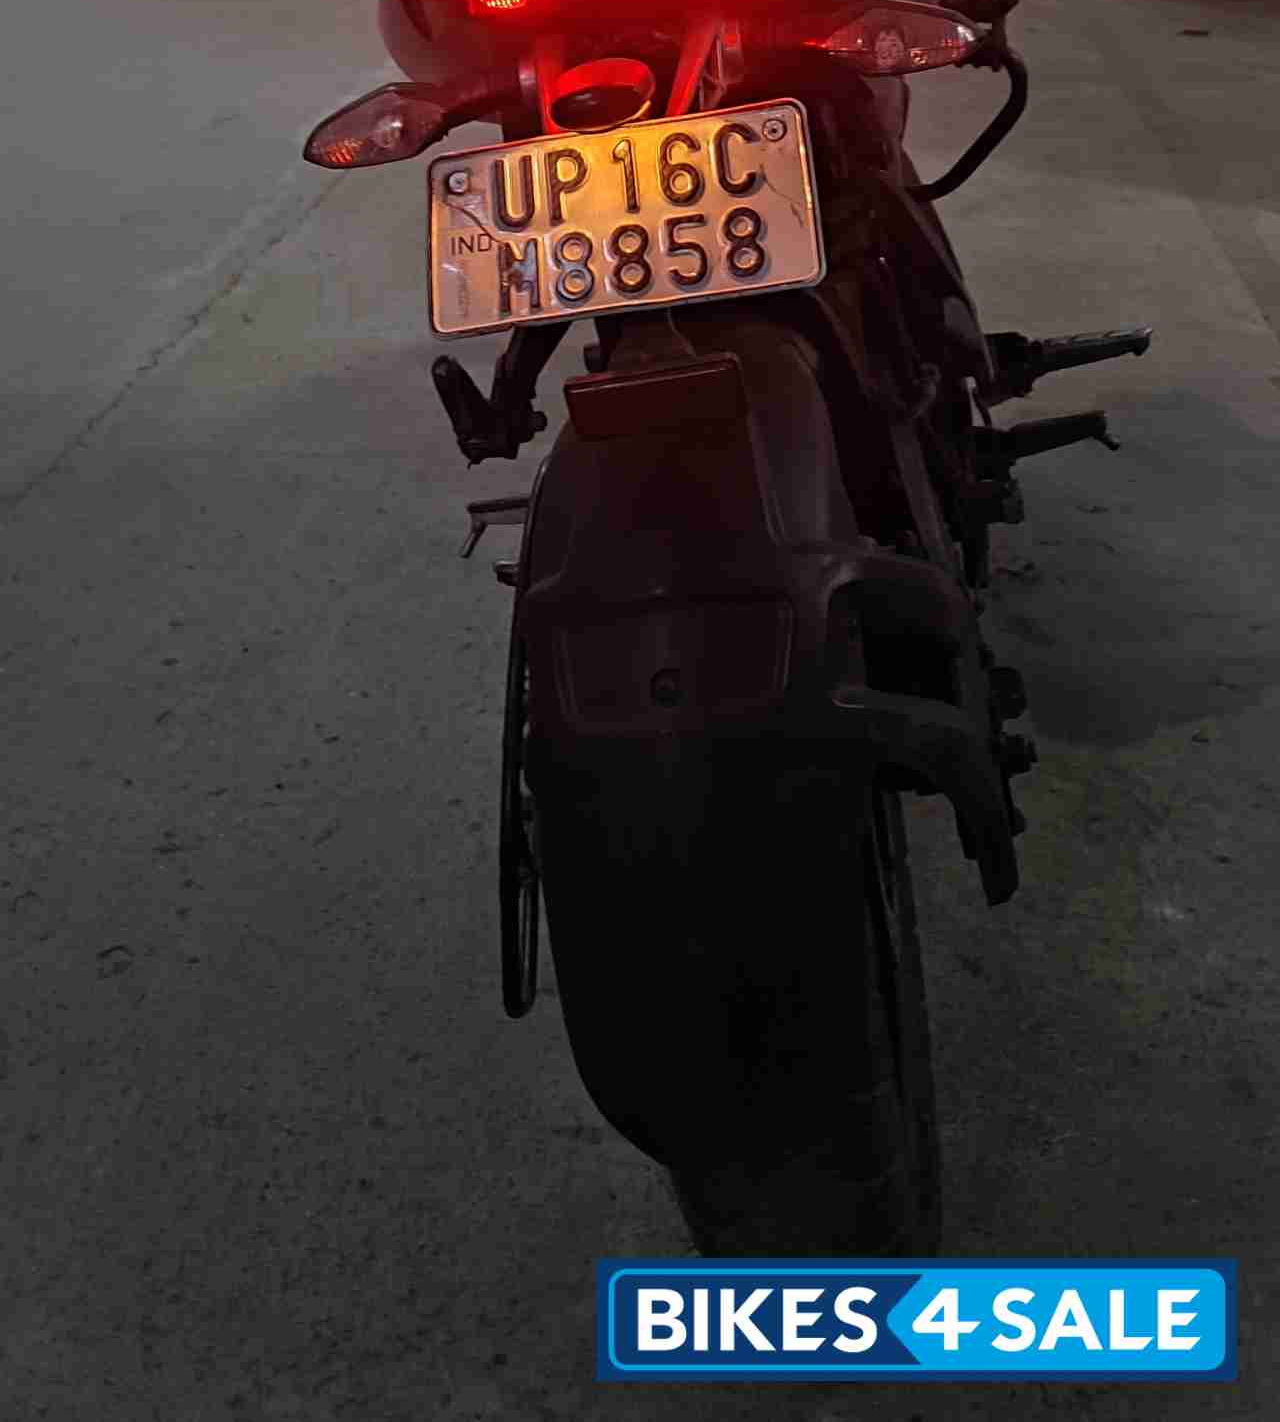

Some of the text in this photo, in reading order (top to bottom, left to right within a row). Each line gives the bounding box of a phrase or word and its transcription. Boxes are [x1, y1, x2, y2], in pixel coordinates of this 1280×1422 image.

[493, 149, 588, 231] UP
[450, 233, 492, 256] IND
[498, 207, 765, 314] M8858
